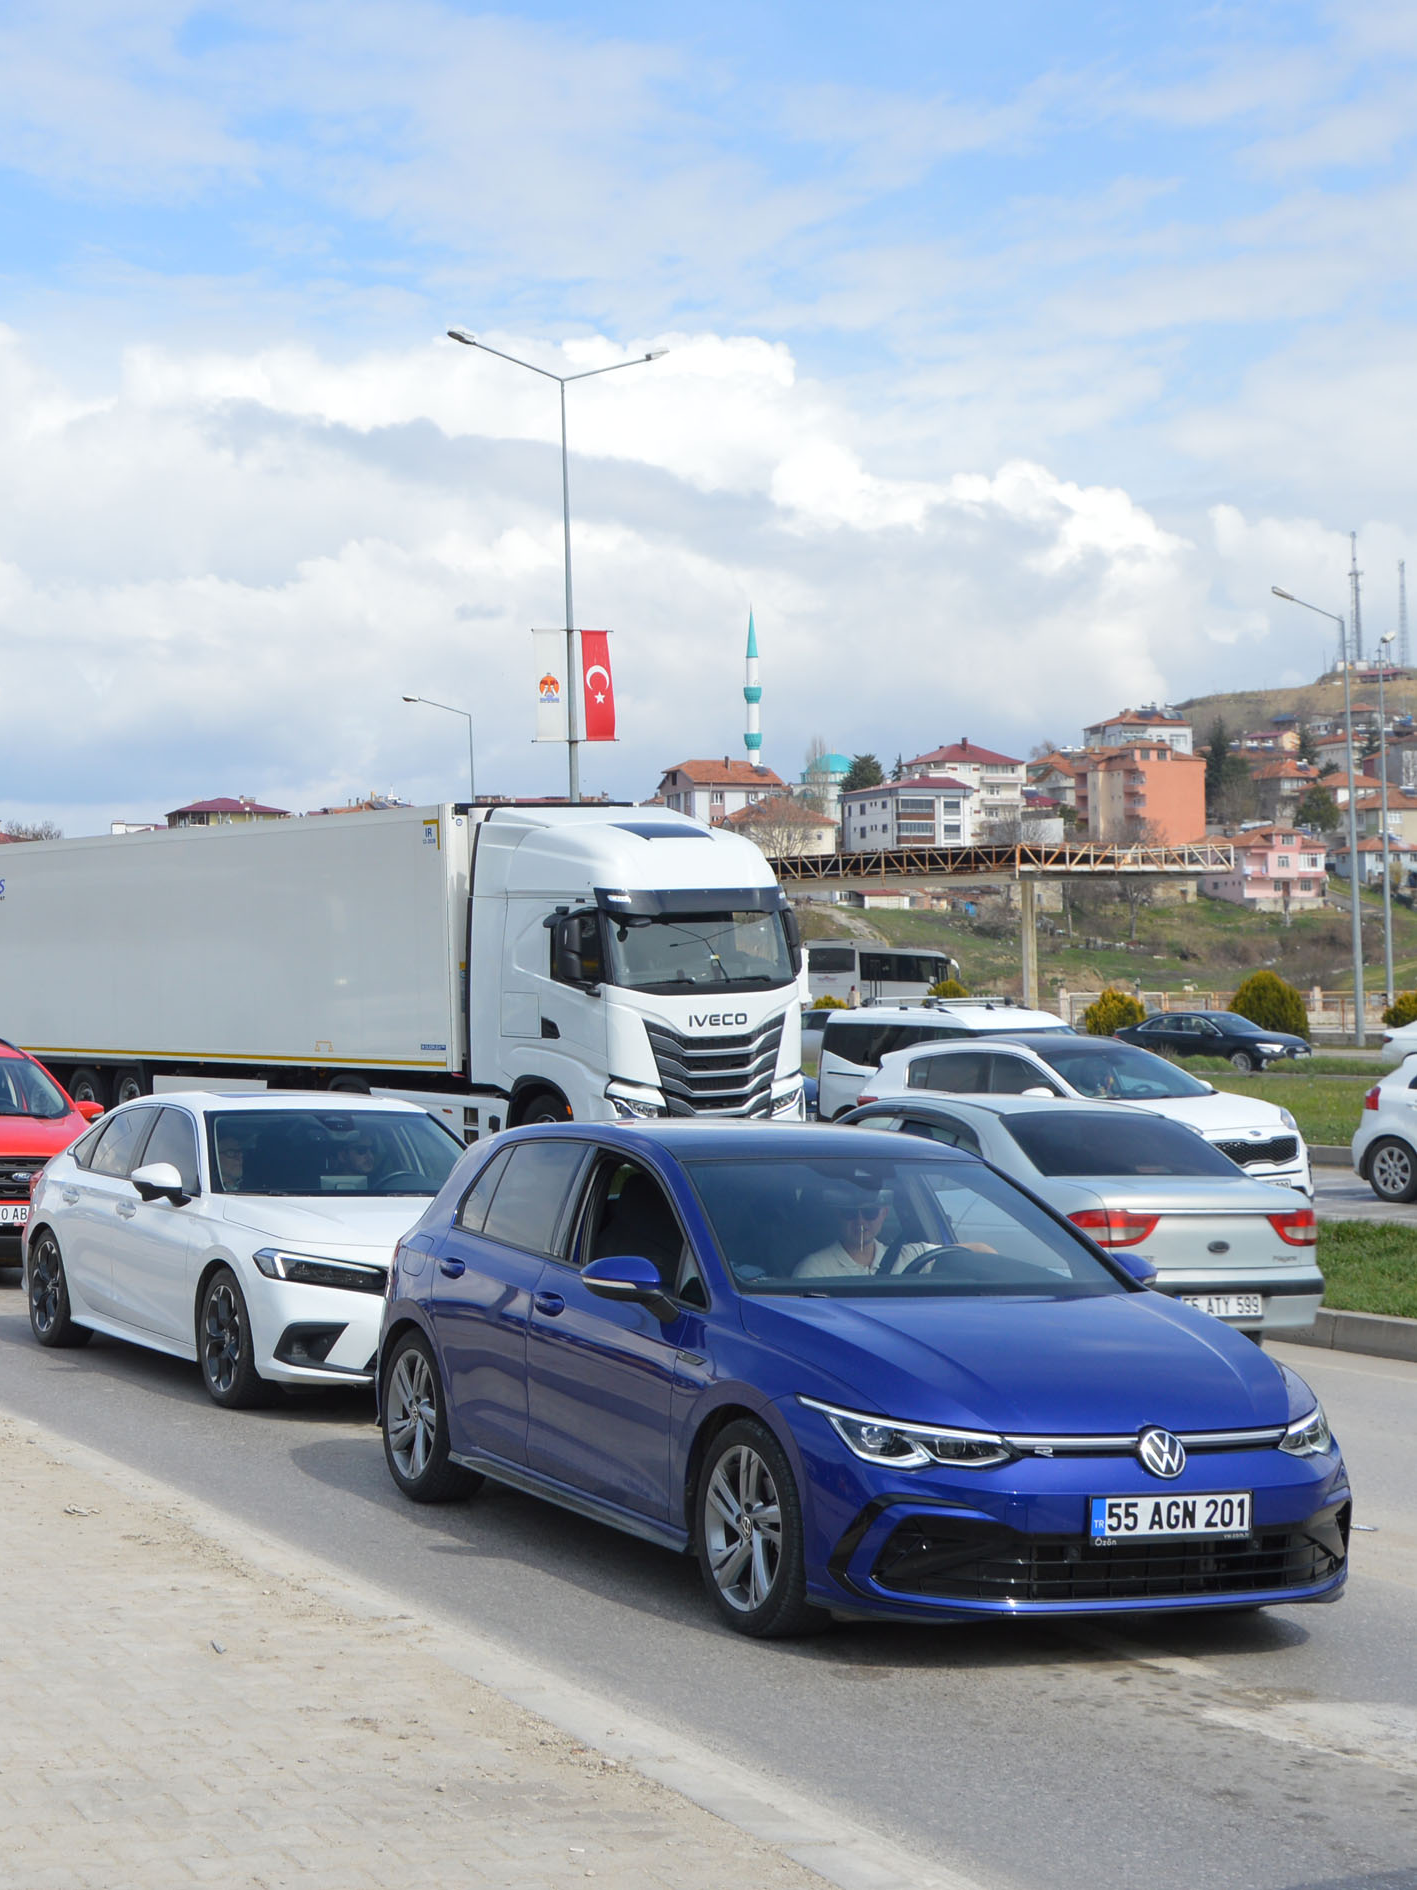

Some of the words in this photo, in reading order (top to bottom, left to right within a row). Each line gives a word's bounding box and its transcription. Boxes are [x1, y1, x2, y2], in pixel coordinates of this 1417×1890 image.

[689, 1013, 747, 1027] IVECO
[1207, 1297, 1230, 1314] ATY
[1237, 1296, 1259, 1313] 599
[1107, 1502, 1139, 1531] 55
[1148, 1499, 1197, 1530] AGN
[1204, 1498, 1246, 1529] 201
[1093, 1519, 1105, 1529] TR
